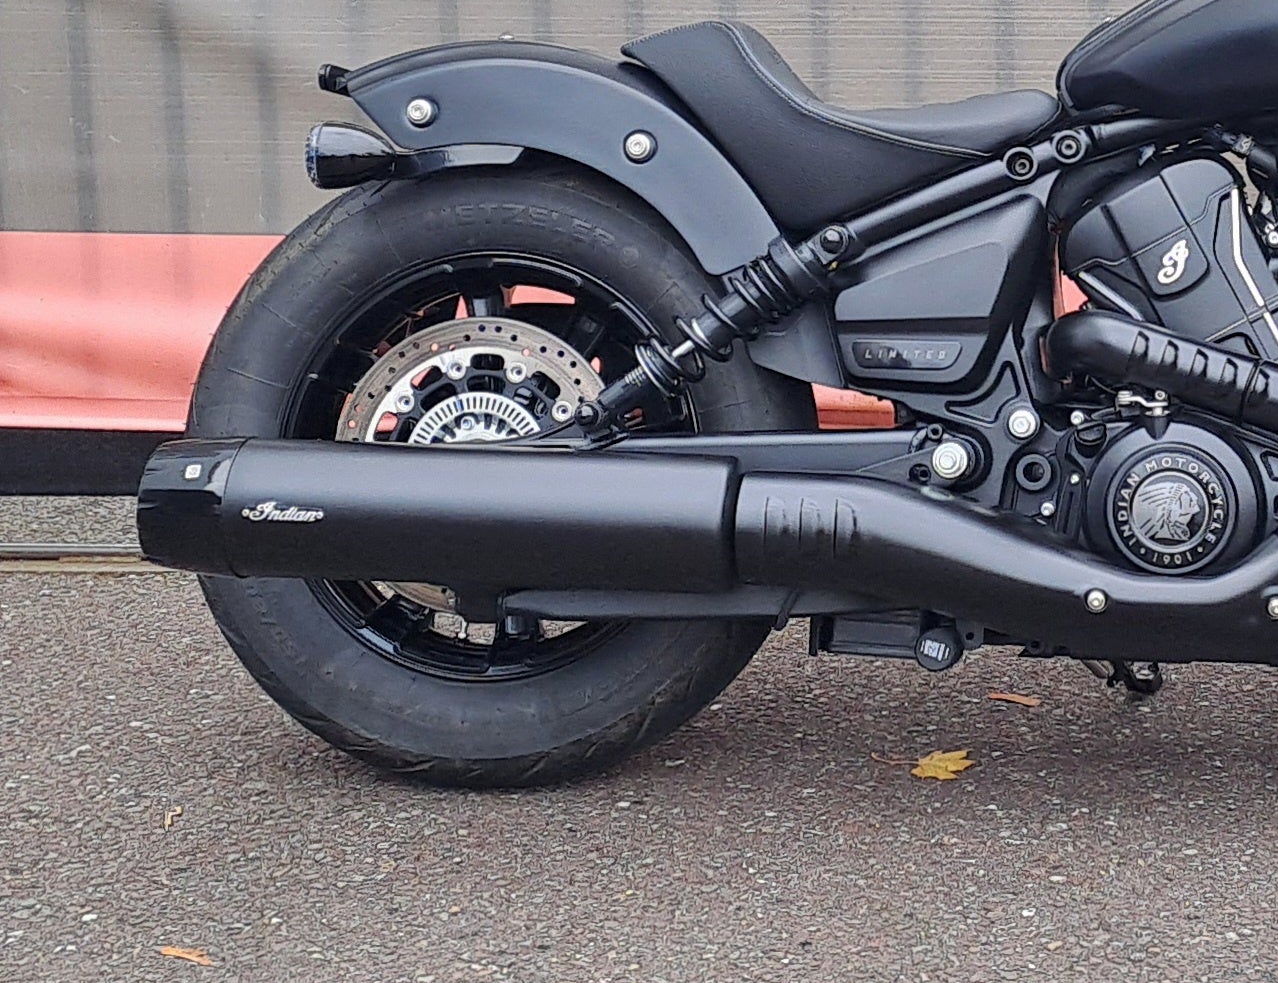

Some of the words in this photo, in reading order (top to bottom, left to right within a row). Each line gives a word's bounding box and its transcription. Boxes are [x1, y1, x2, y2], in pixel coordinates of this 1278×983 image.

[863, 347, 949, 361] LIMITED
[1116, 471, 1143, 547] INDIAN
[1144, 456, 1225, 545] MOTORCYCLE
[243, 501, 324, 522] Indian
[1151, 551, 1193, 565] 1901
